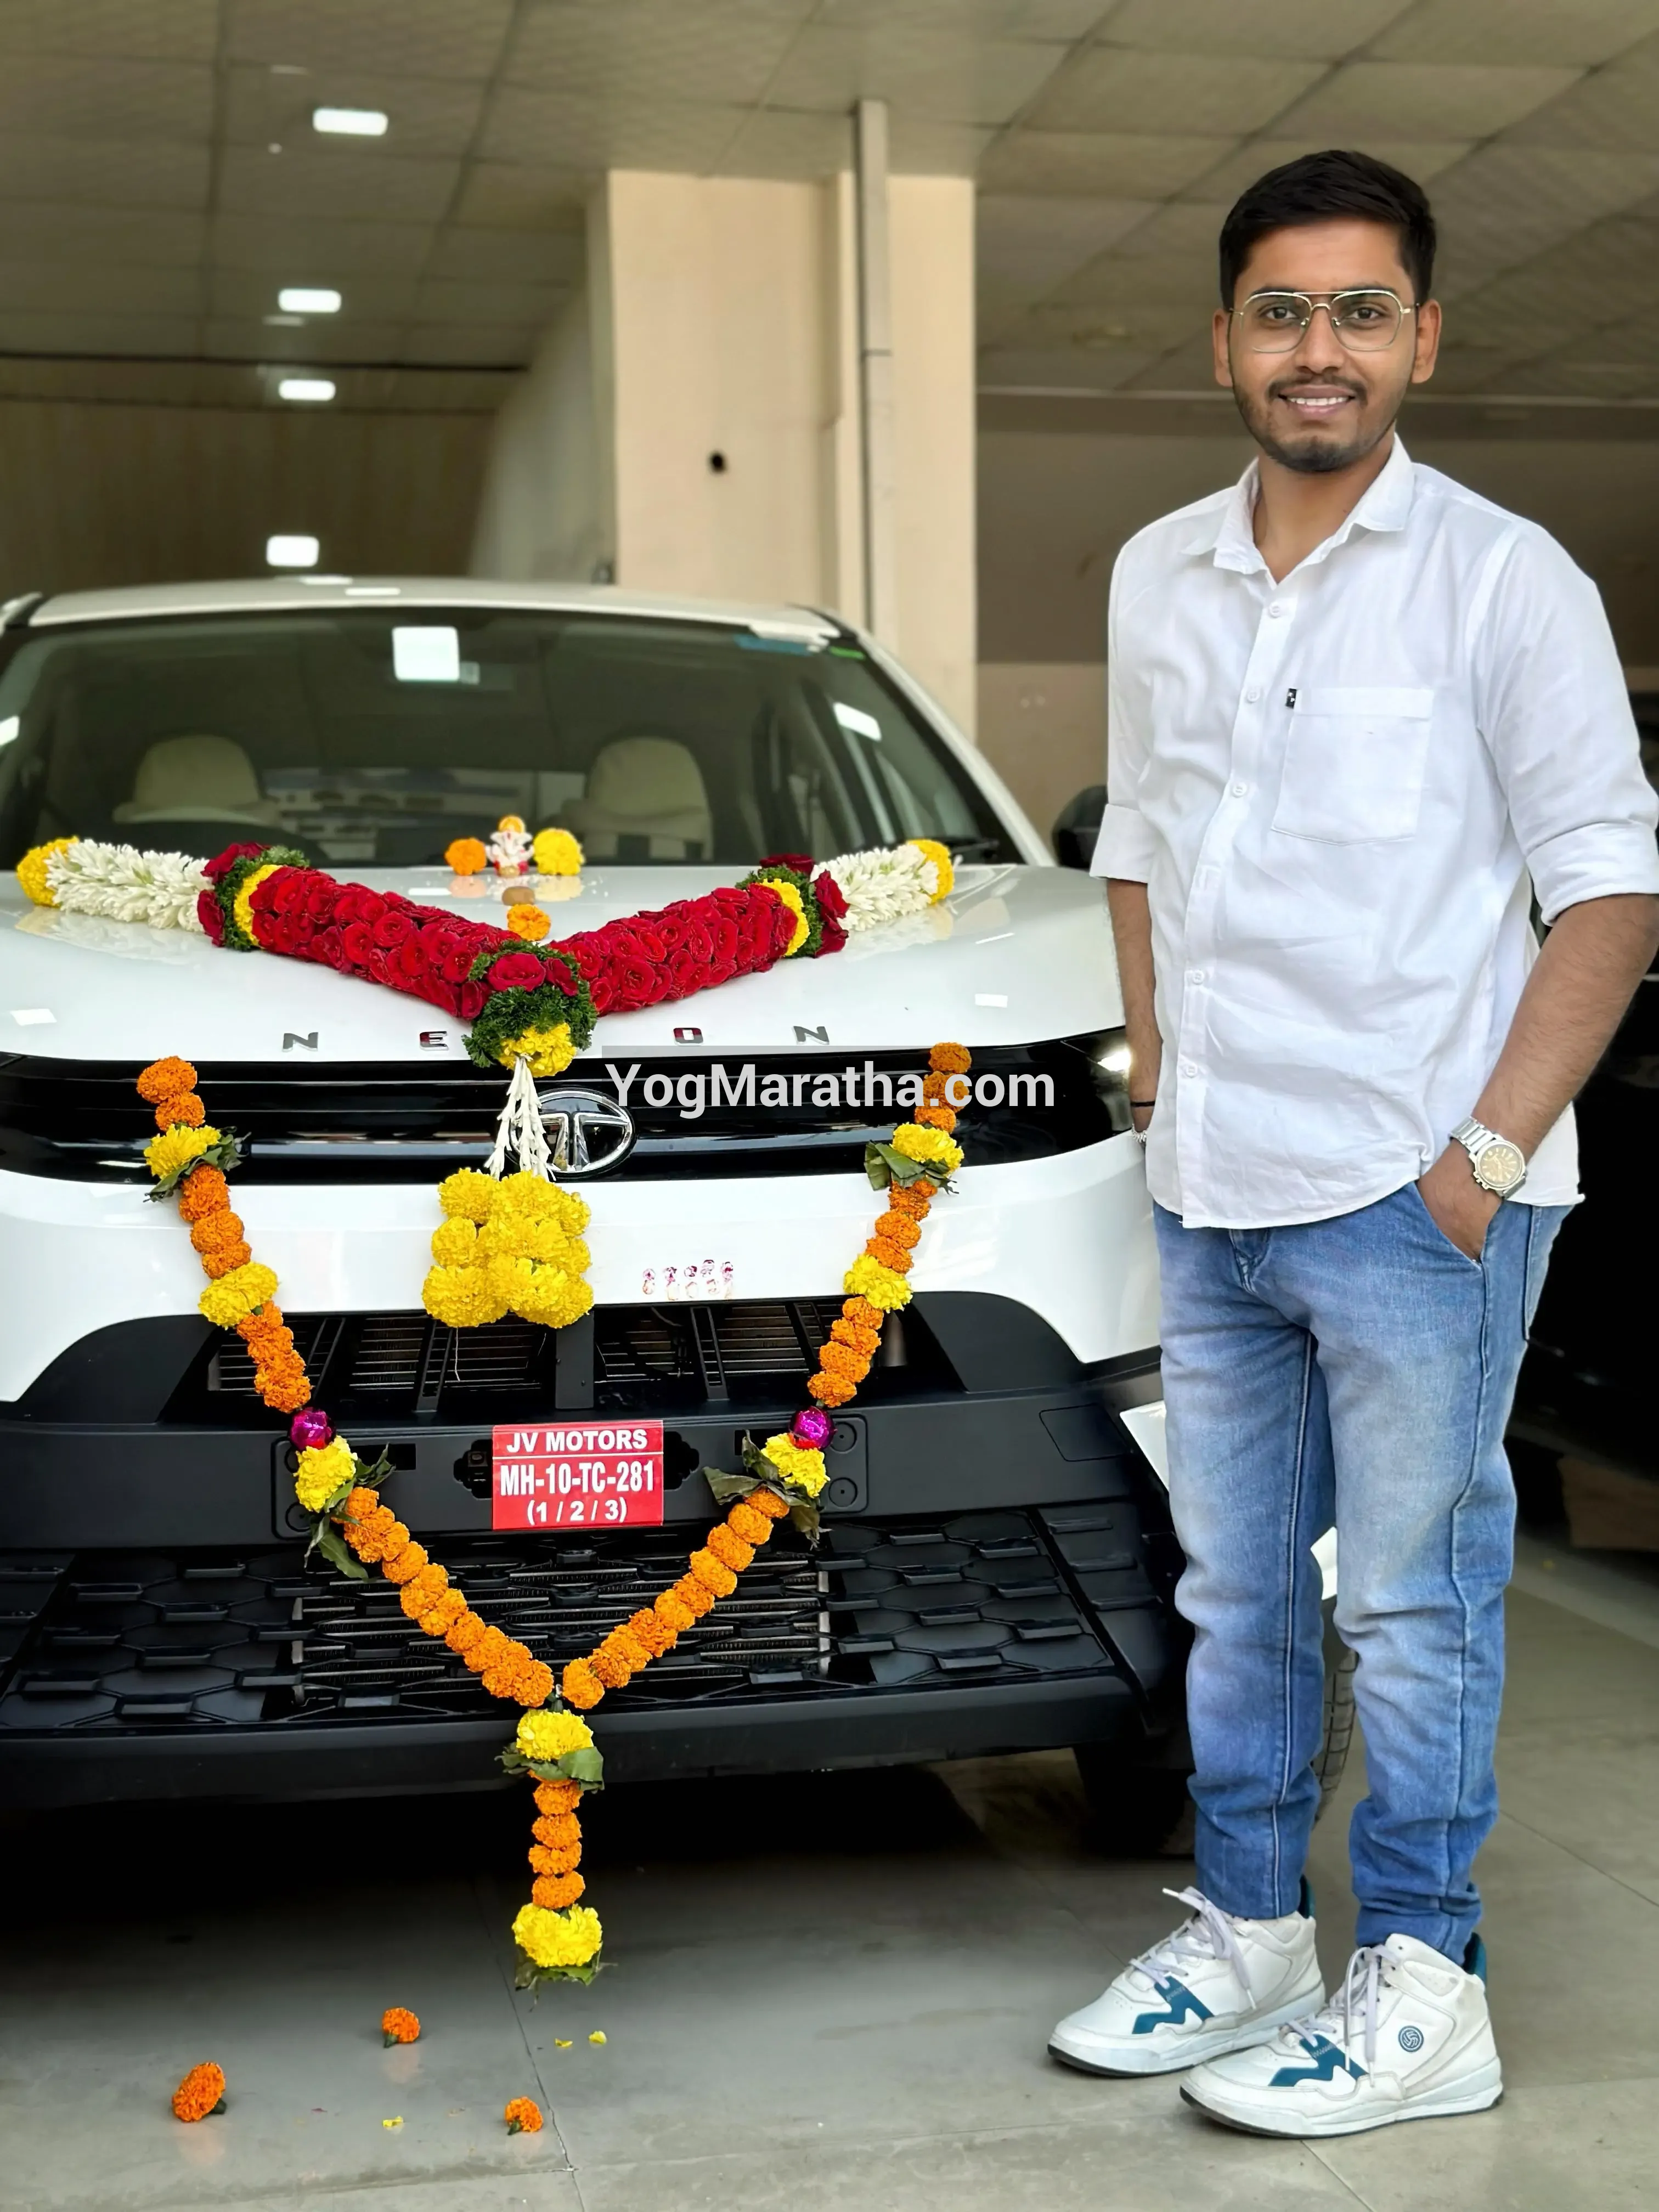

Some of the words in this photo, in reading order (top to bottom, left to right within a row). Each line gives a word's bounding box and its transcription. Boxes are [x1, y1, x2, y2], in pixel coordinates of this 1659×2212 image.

[282, 1025, 830, 1052] NEON
[506, 1432, 539, 1453] JV
[545, 1429, 648, 1452] MOTORS
[500, 1460, 654, 1497] MH-10-TC-281
